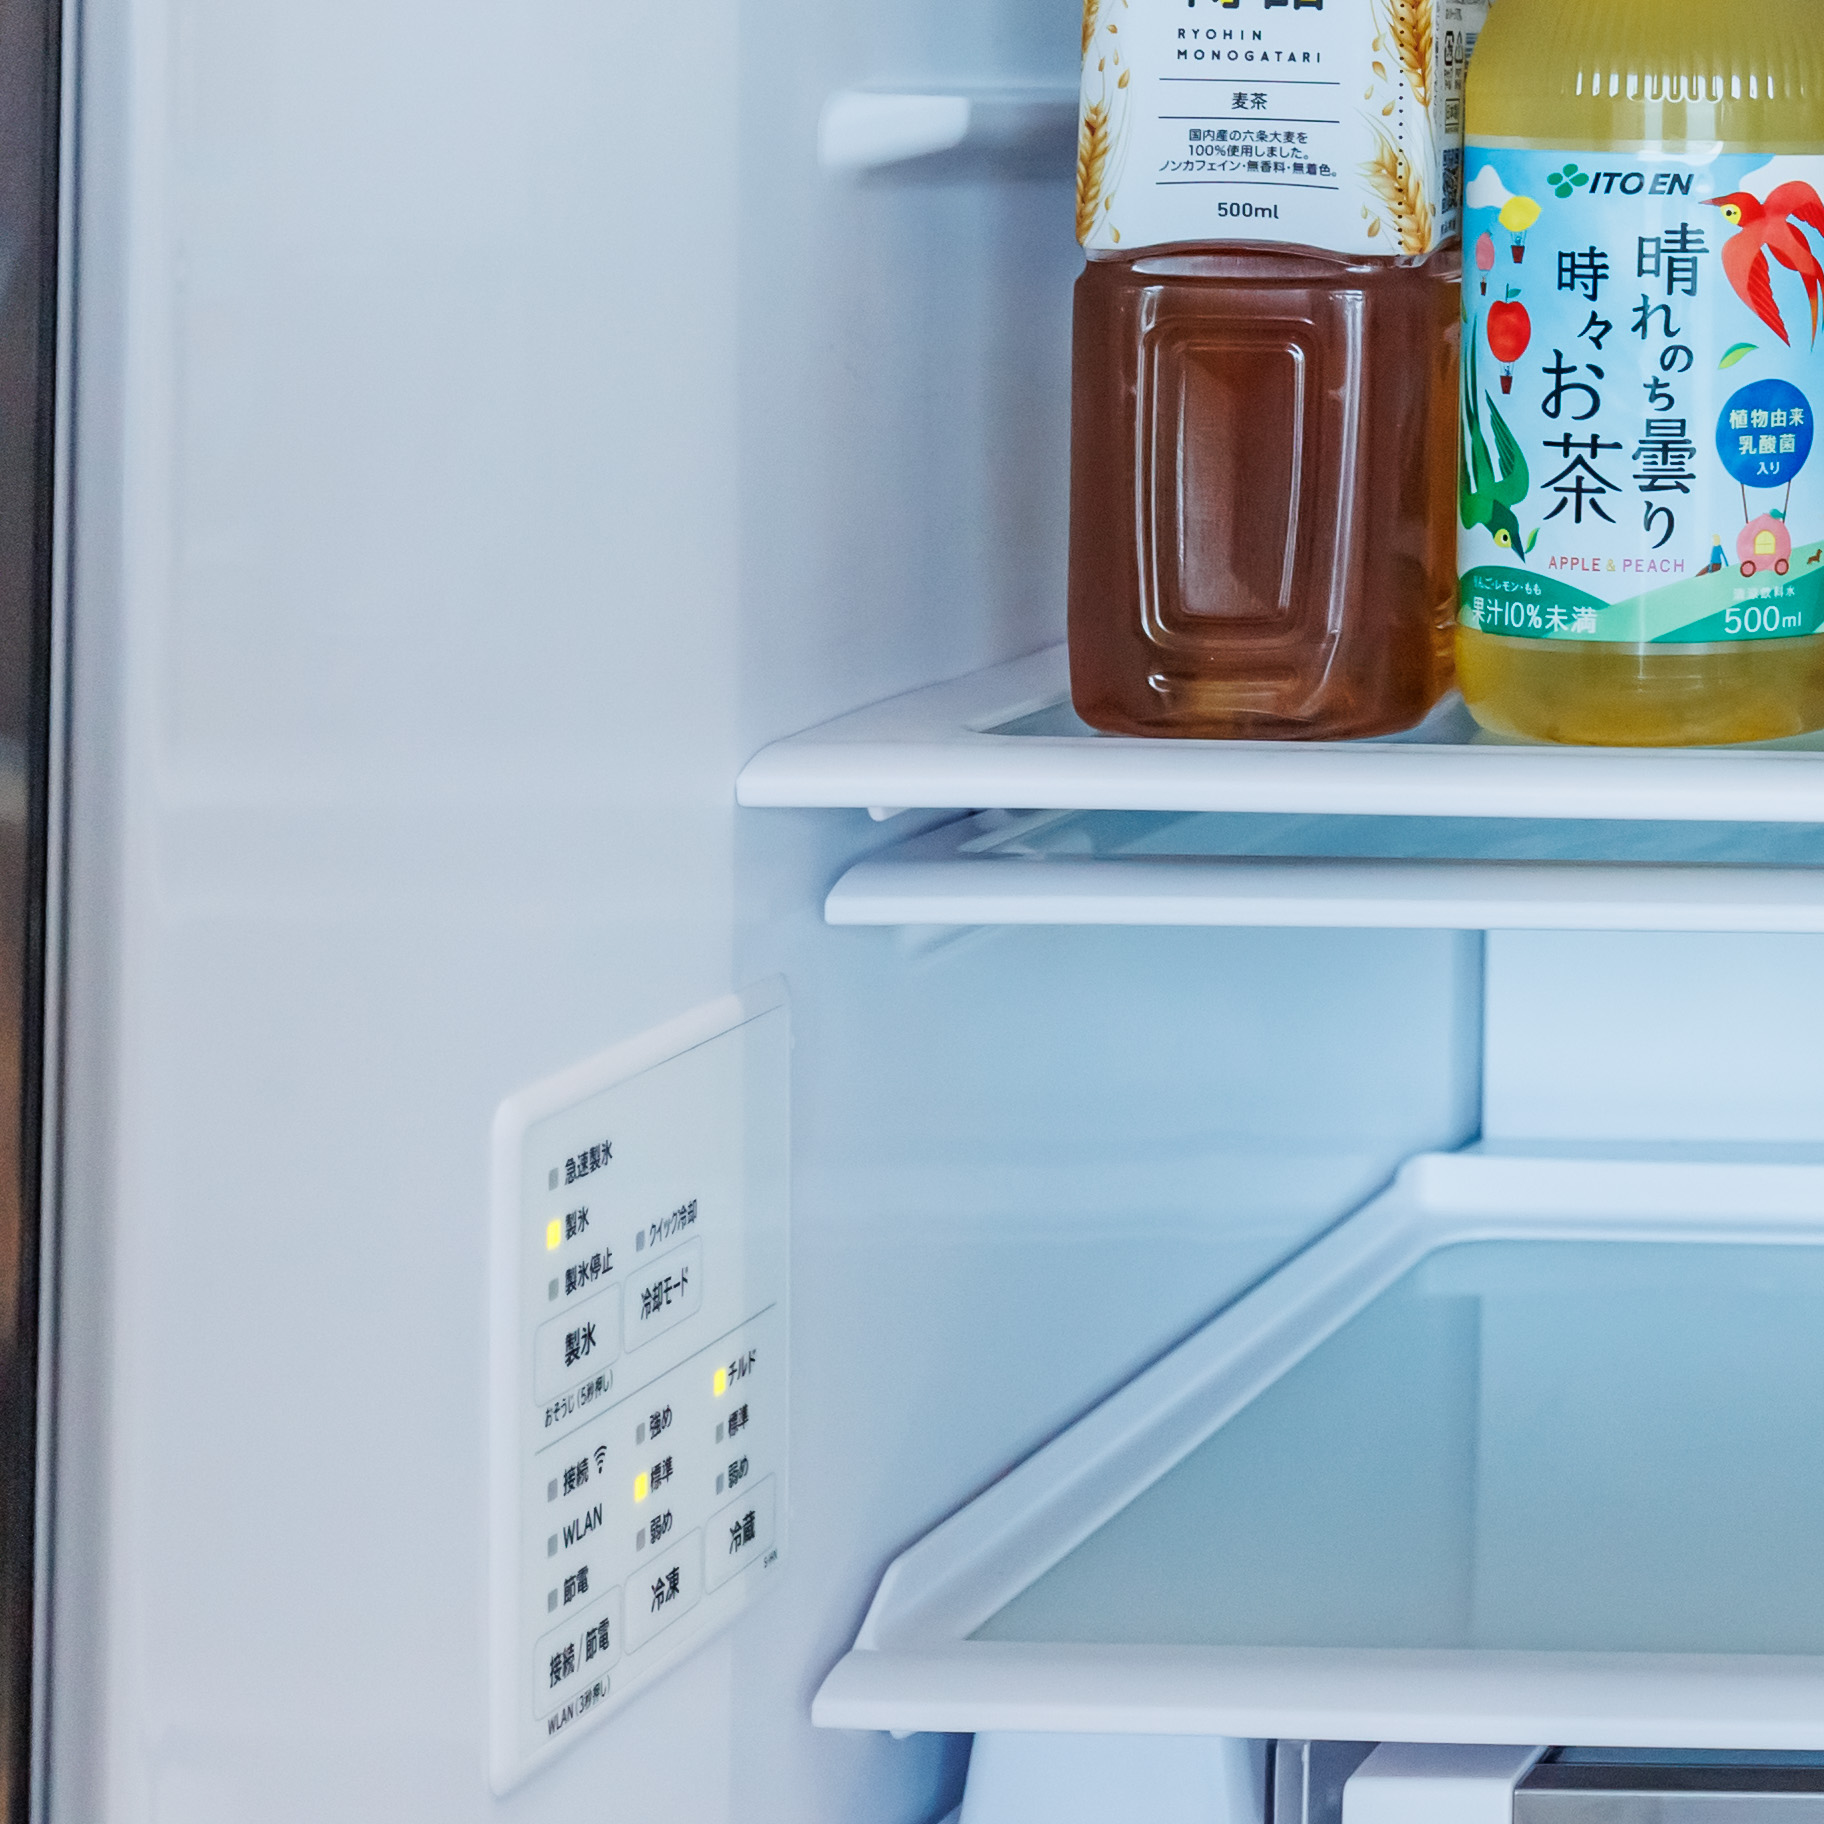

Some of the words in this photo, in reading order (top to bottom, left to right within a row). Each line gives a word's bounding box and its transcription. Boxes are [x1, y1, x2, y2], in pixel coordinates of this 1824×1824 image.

[1178, 28, 1262, 41] RYOHIN
[1177, 49, 1321, 64] MONOGATARI
[1232, 91, 1268, 111] 麦茶
[1188, 129, 1308, 145] 国内産の六条大麦を
[1188, 144, 1309, 159] 100%使用しました。
[1589, 172, 1646, 195] ITO
[1648, 173, 1694, 195] EN
[1217, 202, 1279, 220] 500ml
[1541, 246, 1622, 525] 時々お茶
[1631, 222, 1710, 549] 晴れのち曇り
[1729, 408, 1804, 429] 植物由来
[1738, 434, 1796, 455] 乳酸菌
[1756, 462, 1780, 476] 入り
[1548, 556, 1600, 572] APPLE
[1622, 558, 1684, 573] PEACH
[1472, 596, 1597, 634] 果汁10%未満
[1724, 606, 1801, 634] 500ml
[565, 1140, 613, 1186] 急速製氷
[565, 1206, 589, 1240] 製氷
[650, 1199, 697, 1246] クイック冷却
[565, 1247, 613, 1295] 製氷停止
[641, 1266, 689, 1320] 冷却モード
[565, 1322, 596, 1367] 製氷
[728, 1349, 756, 1386] チルド
[650, 1405, 673, 1440] 強め
[728, 1404, 748, 1438] 標準
[563, 1457, 589, 1496] 接続
[650, 1456, 673, 1493] 標準
[728, 1455, 749, 1489] 弱め
[563, 1503, 602, 1548] WLAN
[650, 1509, 673, 1544] 弱め
[729, 1510, 755, 1554] 冷蔵
[563, 1565, 589, 1606] 節電
[651, 1567, 680, 1612] 冷凍
